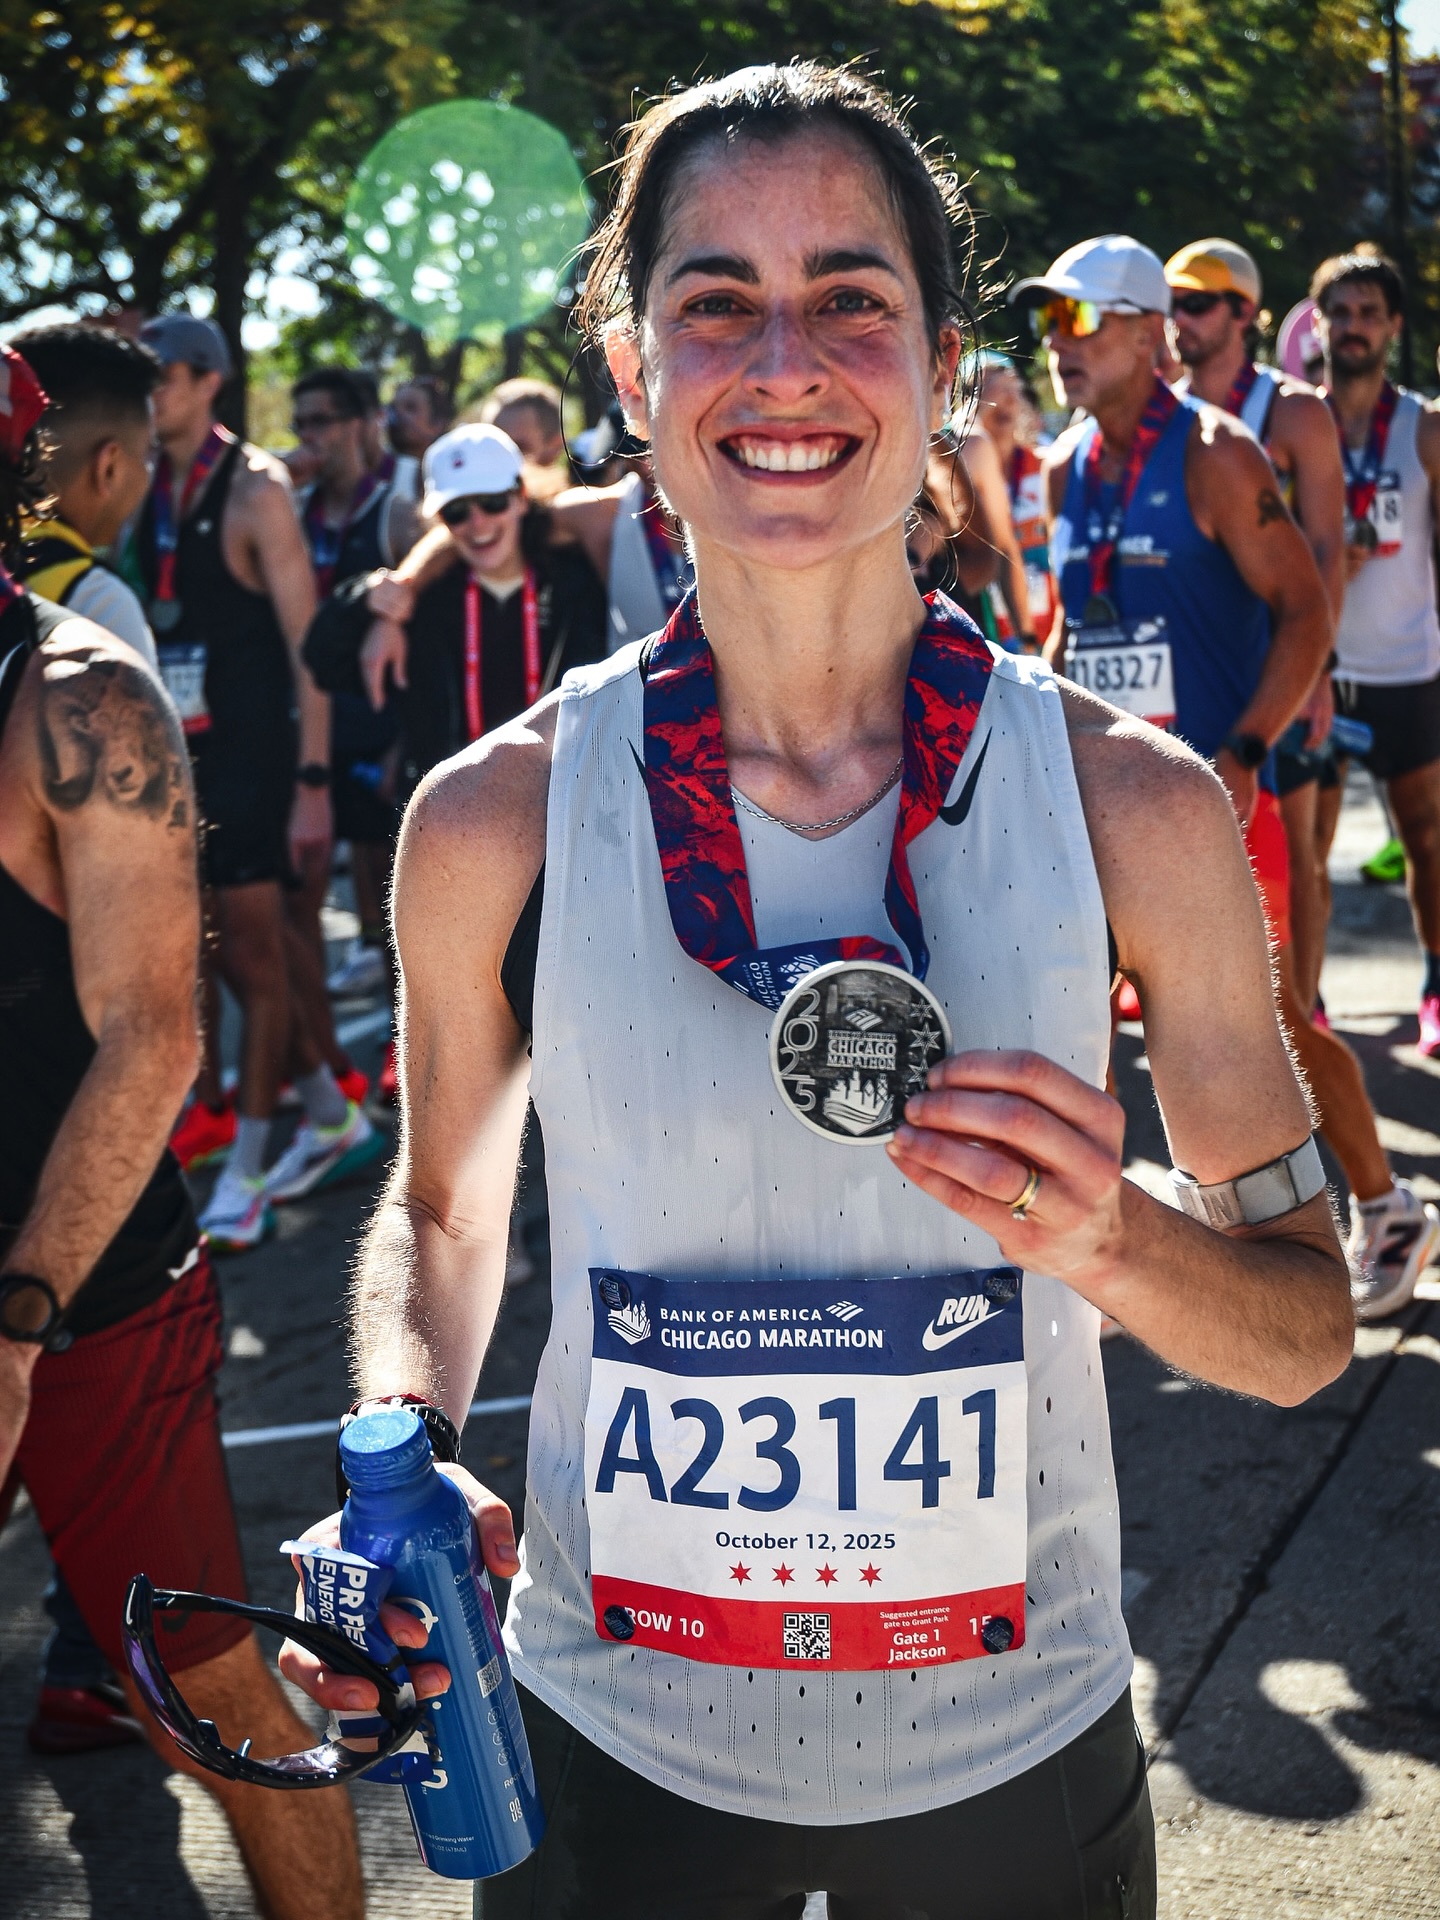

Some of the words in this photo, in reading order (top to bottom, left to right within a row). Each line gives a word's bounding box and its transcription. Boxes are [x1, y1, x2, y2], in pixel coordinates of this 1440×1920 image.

[828, 1039, 896, 1056] CHICAGO
[827, 1054, 896, 1070] MARATHON
[660, 1308, 706, 1322] BANK
[711, 1310, 735, 1322] OF
[738, 1309, 822, 1321] AMERICA
[936, 1294, 991, 1326] RUN
[660, 1328, 751, 1349] CHICAGO
[759, 1328, 884, 1348] MARATHON
[594, 1386, 997, 1512] A23141
[715, 1531, 799, 1550] October
[805, 1532, 837, 1553] 12,
[844, 1533, 896, 1550] 2025
[880, 1610, 917, 1620] Suggested
[919, 1607, 950, 1616] entrance
[883, 1620, 901, 1630] gate
[901, 1619, 911, 1628] to
[911, 1616, 932, 1627] Grant
[933, 1614, 949, 1624] Park
[679, 1617, 705, 1639] 10
[893, 1632, 929, 1646] Gate
[933, 1628, 941, 1642] 1
[887, 1645, 947, 1664] Jackson
